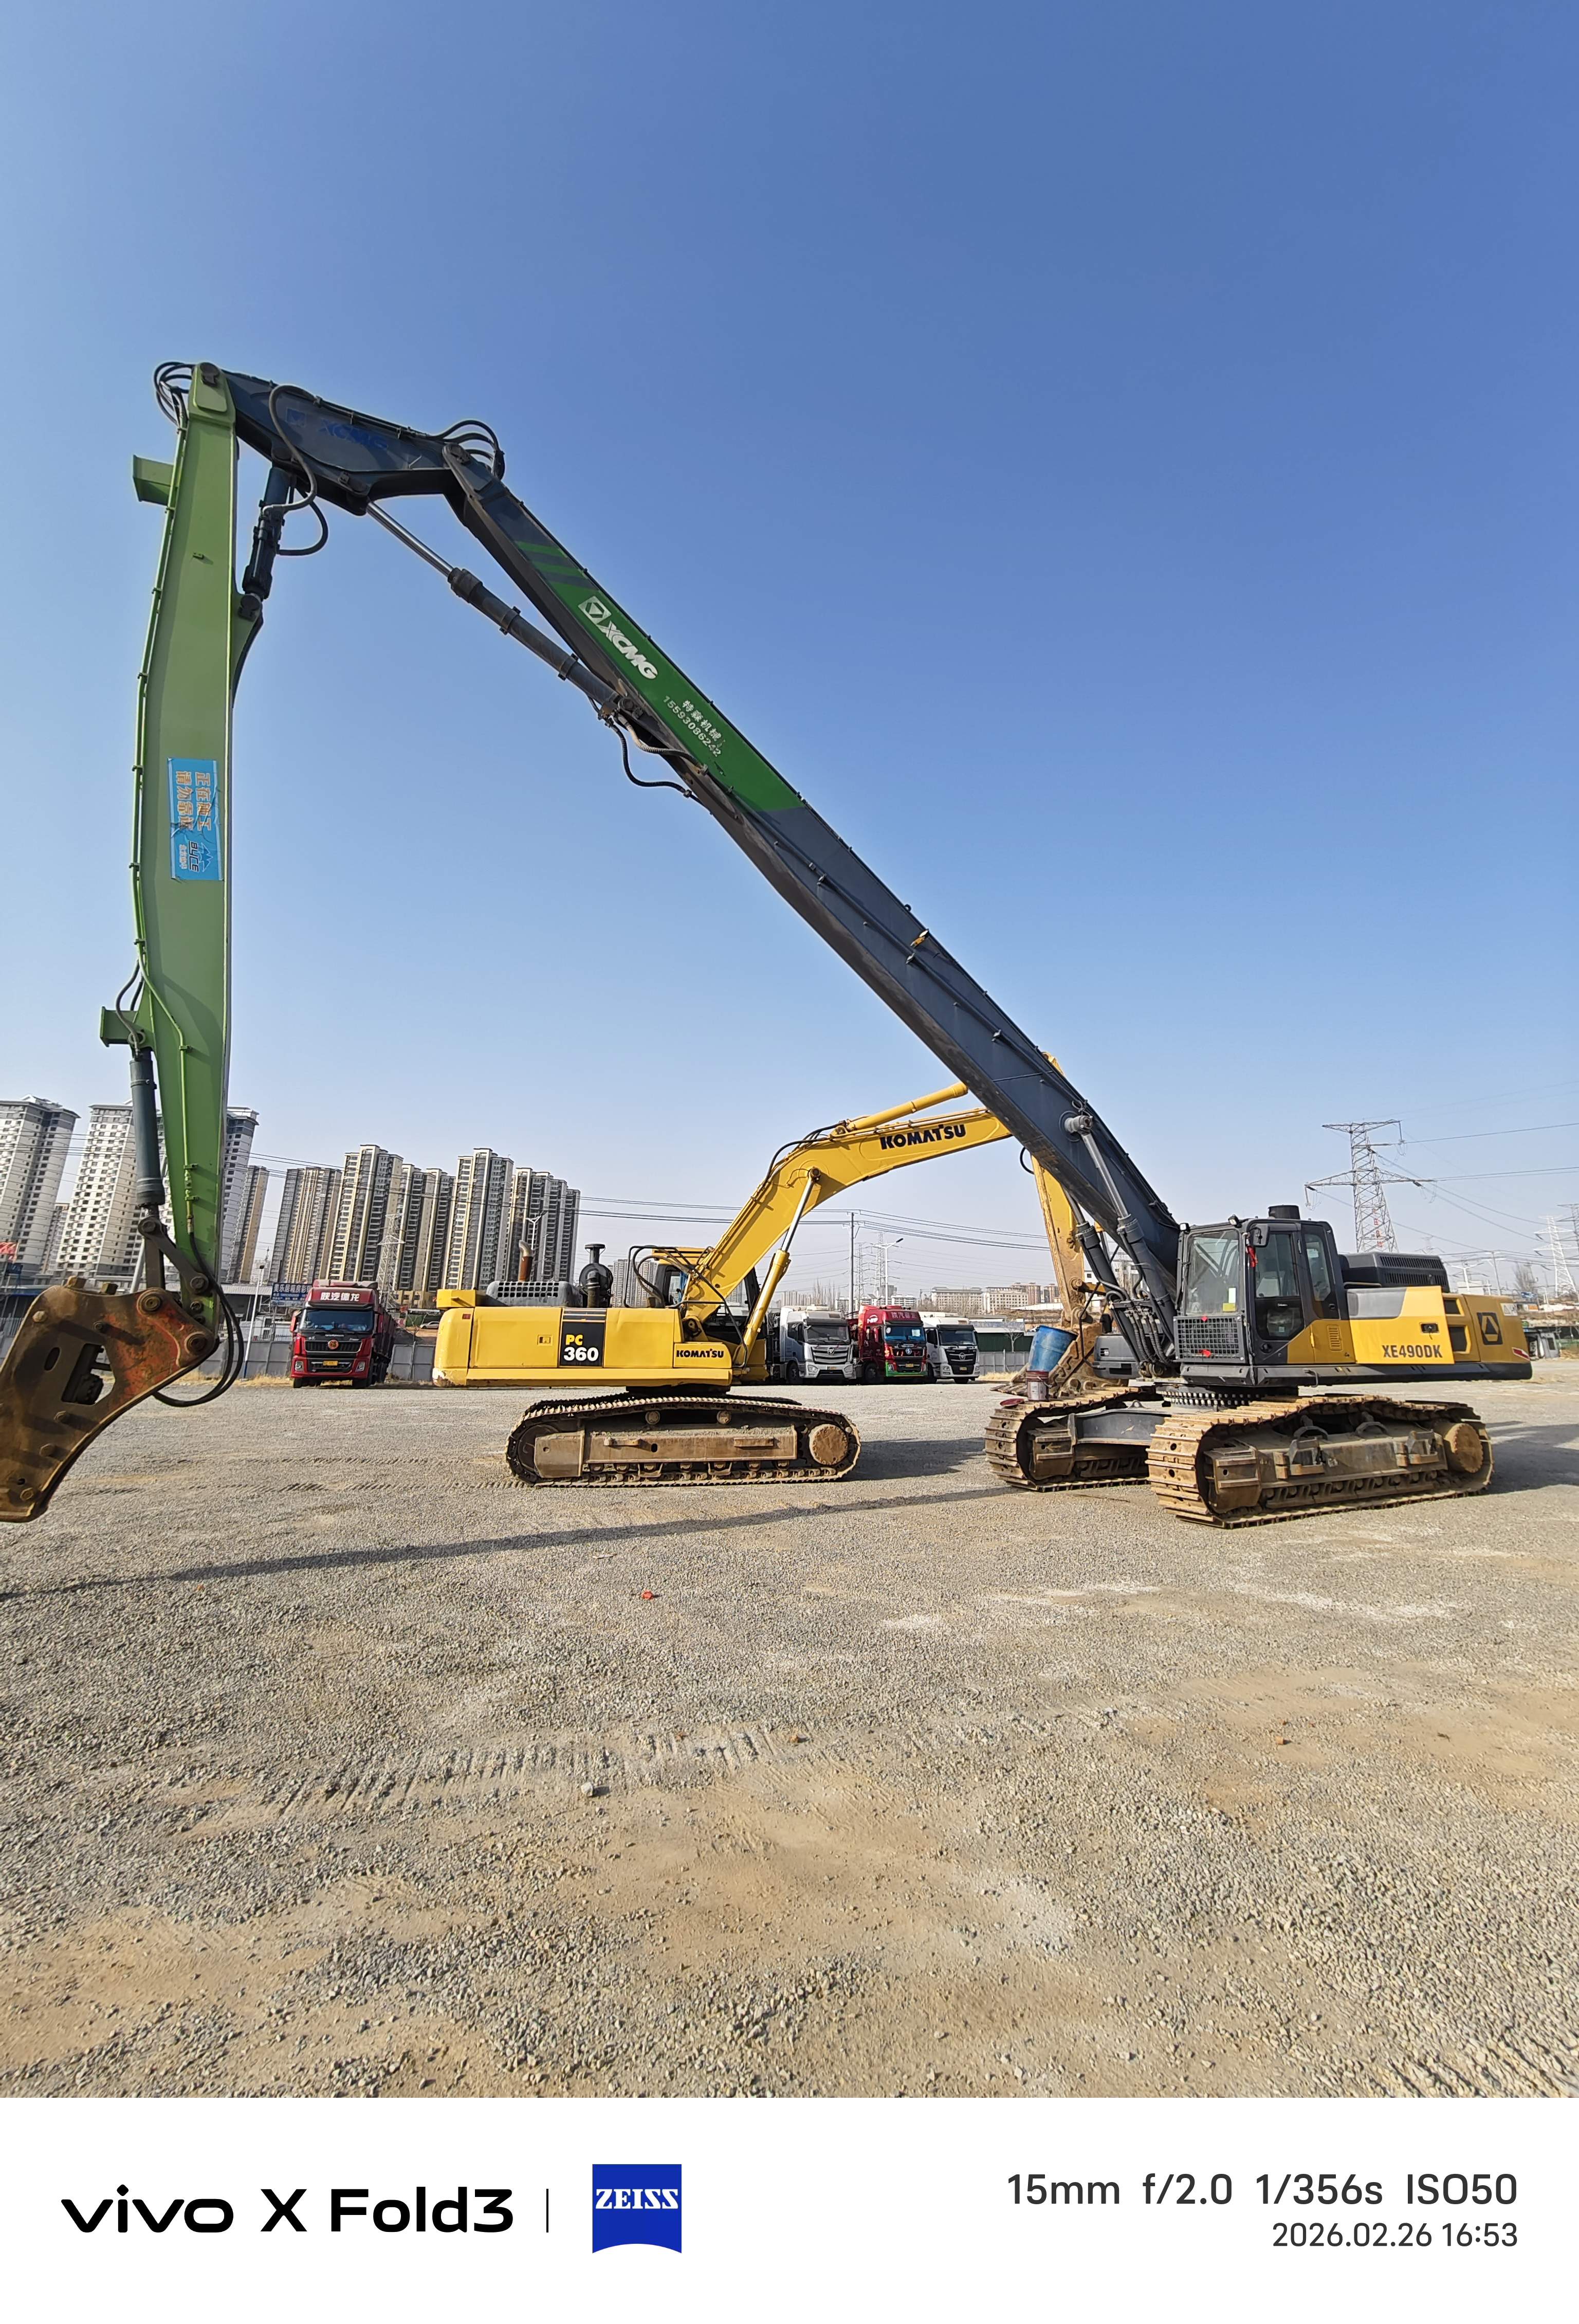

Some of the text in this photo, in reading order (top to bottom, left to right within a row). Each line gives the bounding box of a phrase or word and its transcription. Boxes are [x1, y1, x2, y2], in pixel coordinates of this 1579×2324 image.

[596, 621, 658, 679] XCMG
[176, 771, 194, 831] 请勿靠近
[195, 772, 212, 831] 正在施工
[188, 840, 199, 873] BYCE
[879, 1124, 966, 1150] KOMATSU
[320, 1292, 360, 1301] 陕汽德龙
[566, 1334, 583, 1346] PC
[564, 1347, 599, 1361] 360
[676, 1348, 724, 1358] KOMATSU
[1382, 1345, 1443, 1358] XE490DK
